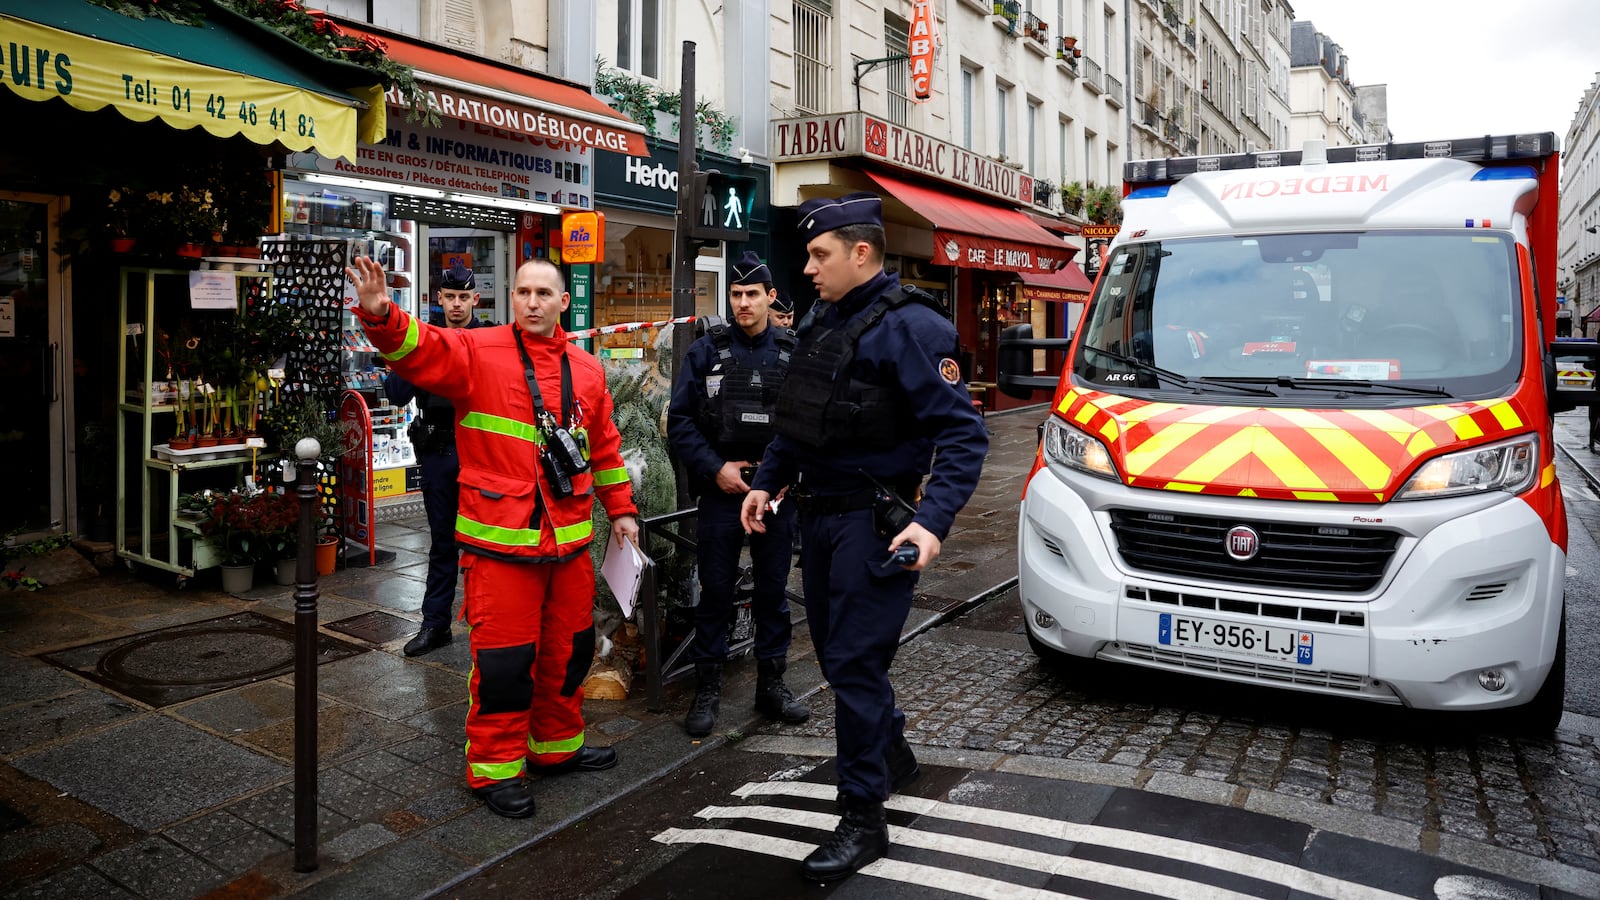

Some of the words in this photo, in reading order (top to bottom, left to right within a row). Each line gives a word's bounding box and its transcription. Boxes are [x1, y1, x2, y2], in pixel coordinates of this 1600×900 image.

[912, 2, 930, 93] TABAC
[122, 74, 157, 106] Tel:
[172, 86, 191, 112] 01
[206, 94, 226, 120] 42
[239, 101, 257, 126] 46
[270, 107, 286, 131] 41
[298, 114, 315, 138] 82
[385, 84, 520, 130] RARATION
[523, 112, 629, 151] DÉBLOCAGE
[408, 133, 421, 151] &
[426, 136, 553, 174] INFORMATIQUES
[778, 117, 846, 157] TABAC
[335, 160, 404, 180] Accessoires
[413, 171, 446, 186] Pièces
[449, 177, 498, 193] détachées
[379, 151, 393, 163] EN
[396, 154, 427, 168] GROS
[436, 159, 472, 176] DÉTAIL
[474, 167, 530, 184] TELEPHONE
[891, 127, 946, 175] TABAC
[952, 149, 970, 183] LE
[974, 157, 1017, 198] MAYOL
[570, 226, 590, 242] Ria
[1084, 227, 1118, 235] NICOLAS
[968, 248, 986, 264] CAFE
[994, 248, 1003, 265] LE
[1005, 250, 1033, 268] MAYOL
[1232, 536, 1252, 552] FIAT
[1176, 619, 1294, 655] EY-956-LJ
[1299, 647, 1310, 659] 75
